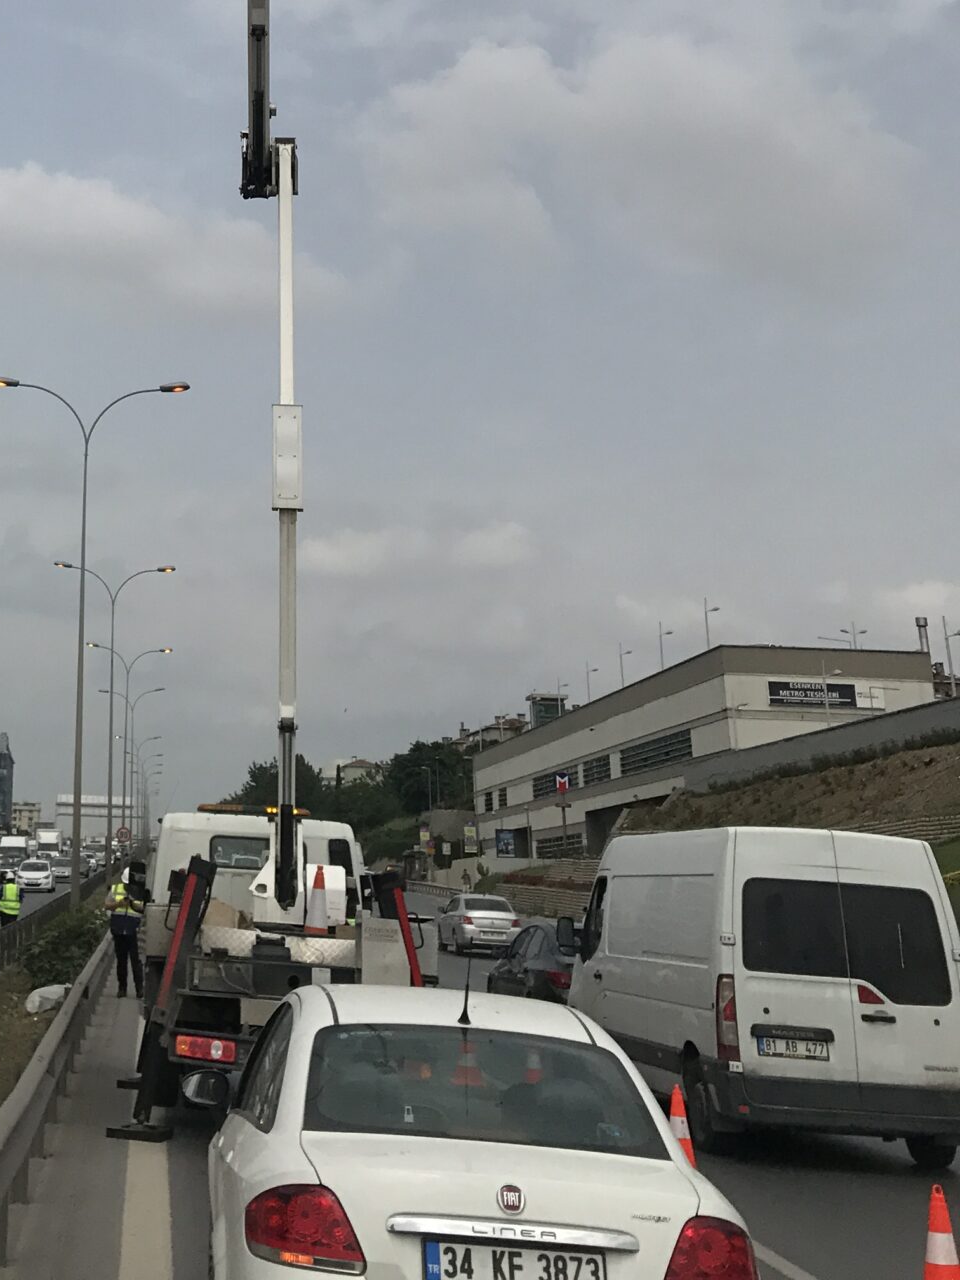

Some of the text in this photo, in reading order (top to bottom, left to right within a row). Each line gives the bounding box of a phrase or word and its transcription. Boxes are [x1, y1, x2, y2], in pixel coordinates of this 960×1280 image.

[785, 1040, 798, 1053] AB
[806, 1042, 825, 1056] 477
[503, 1191, 520, 1207] FIAT
[471, 1225, 557, 1241] LINEA
[427, 1246, 601, 1280] TR 34 KF 3873
